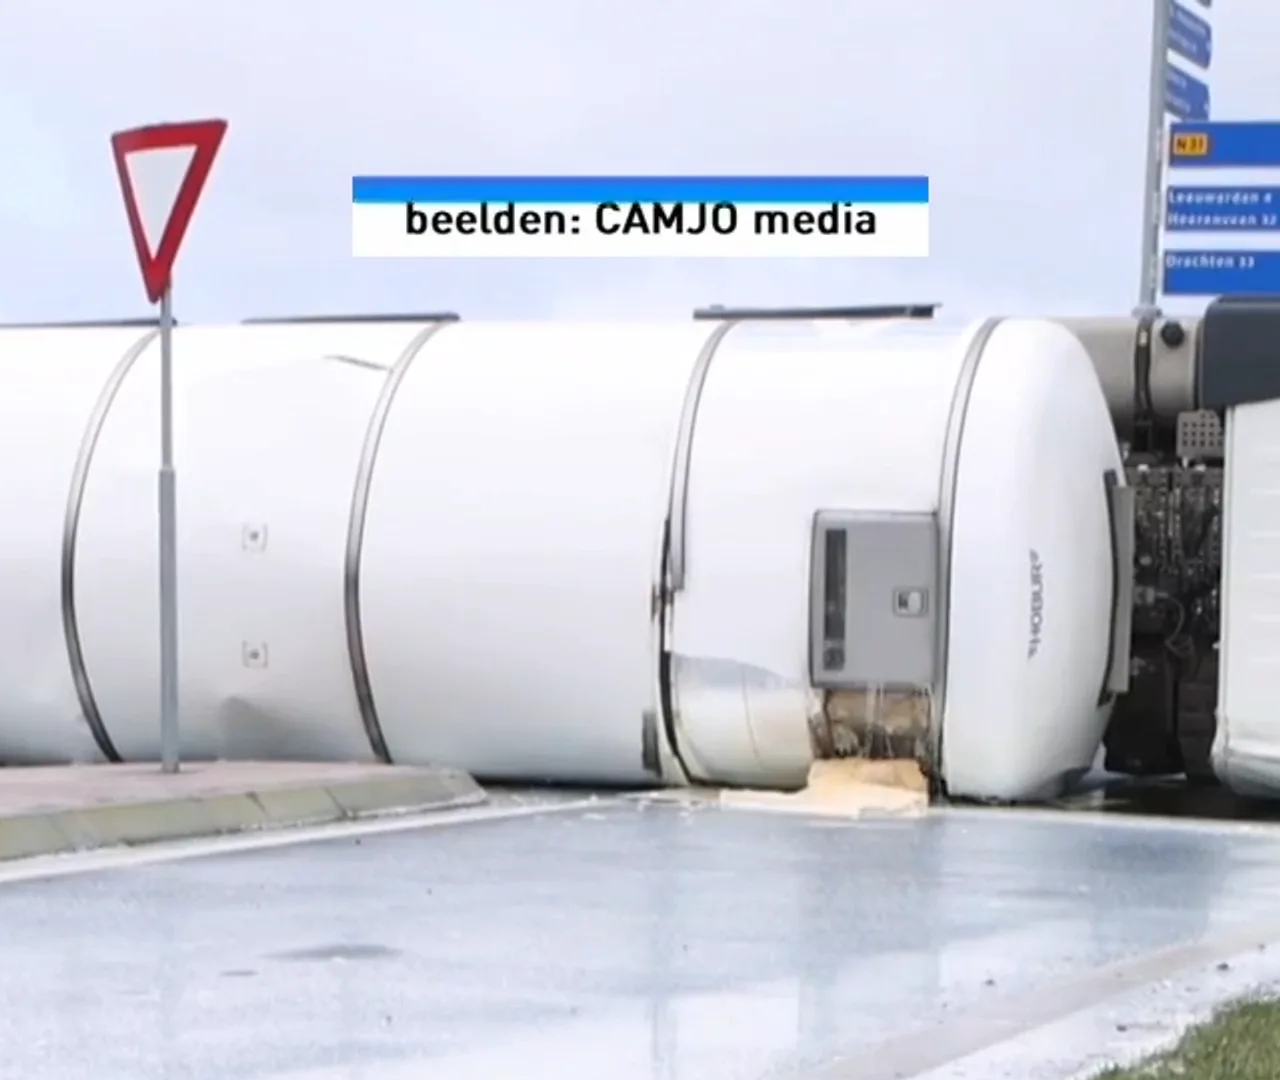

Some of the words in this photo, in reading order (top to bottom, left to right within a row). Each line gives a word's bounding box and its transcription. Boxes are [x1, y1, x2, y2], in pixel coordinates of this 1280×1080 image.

[1168, 191, 1260, 205] Leeuwarden
[1167, 213, 1257, 226] Heerenveen
[1165, 254, 1234, 269] Drachten
